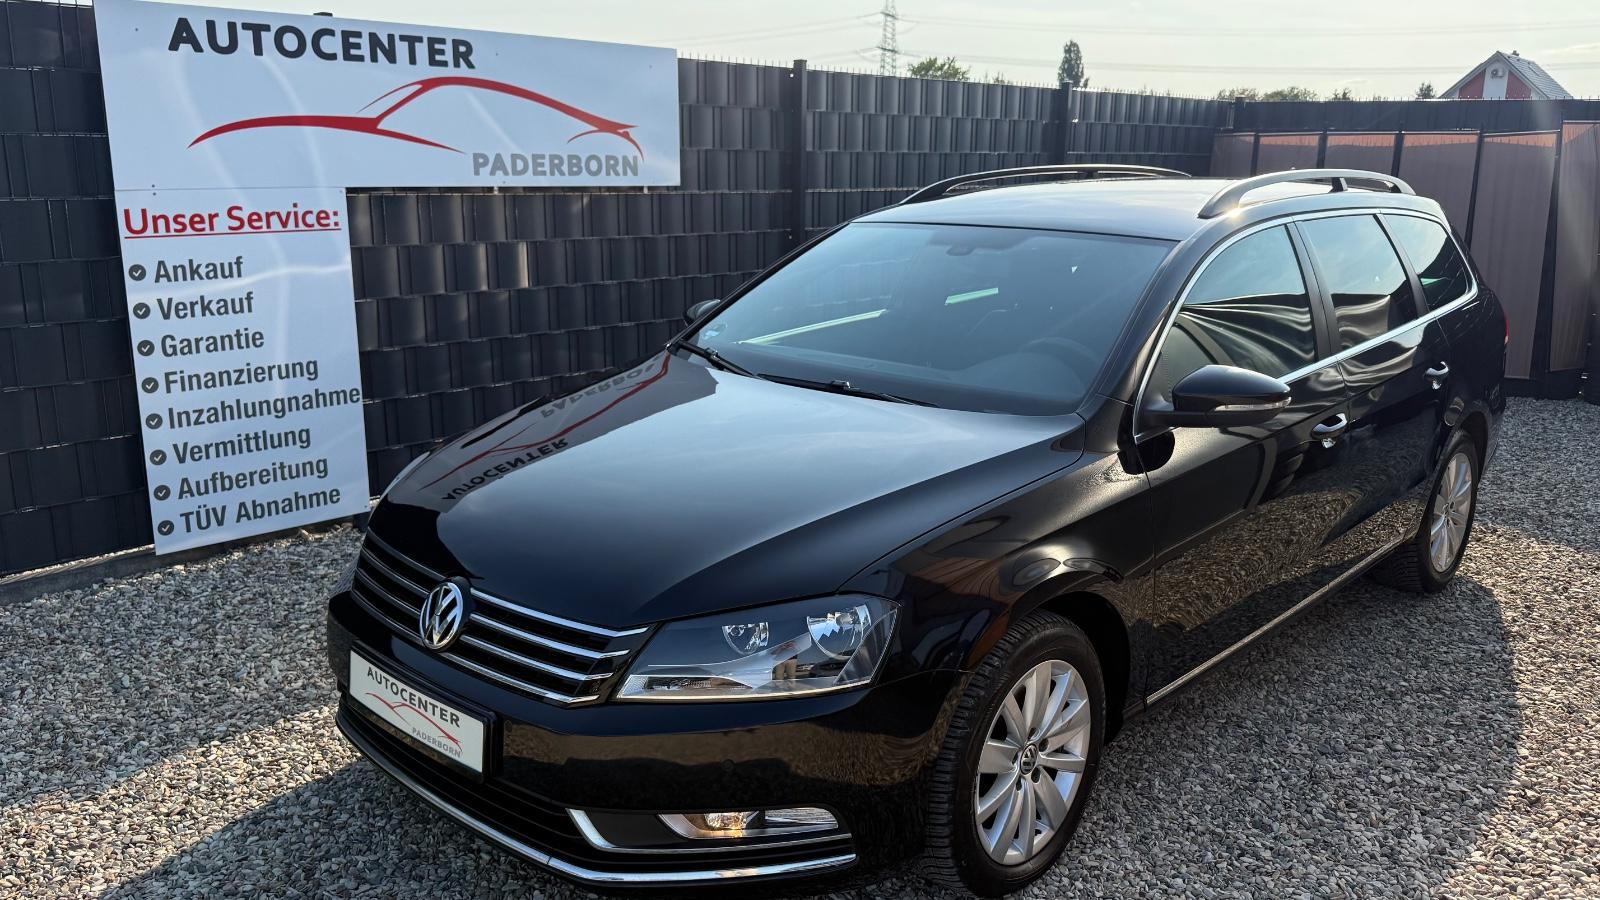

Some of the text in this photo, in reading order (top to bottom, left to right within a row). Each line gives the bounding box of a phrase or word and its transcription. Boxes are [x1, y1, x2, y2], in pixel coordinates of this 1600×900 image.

[168, 17, 476, 69] AUTOCENTER
[471, 152, 640, 177] PADERBORN
[123, 203, 340, 235] Unser Service:
[154, 256, 243, 283] Ankauf
[156, 291, 254, 320] Verkauf
[161, 328, 264, 357] Garantie
[164, 359, 319, 394] Finanzierung
[168, 387, 361, 429] Inzahlungnahme
[173, 428, 311, 464] Vermittlung
[178, 457, 328, 500] Aufbereitung
[180, 488, 341, 533] TÜV Abnahme
[367, 666, 460, 728] AUTOCENTER
[412, 727, 461, 758] PADERBORN
